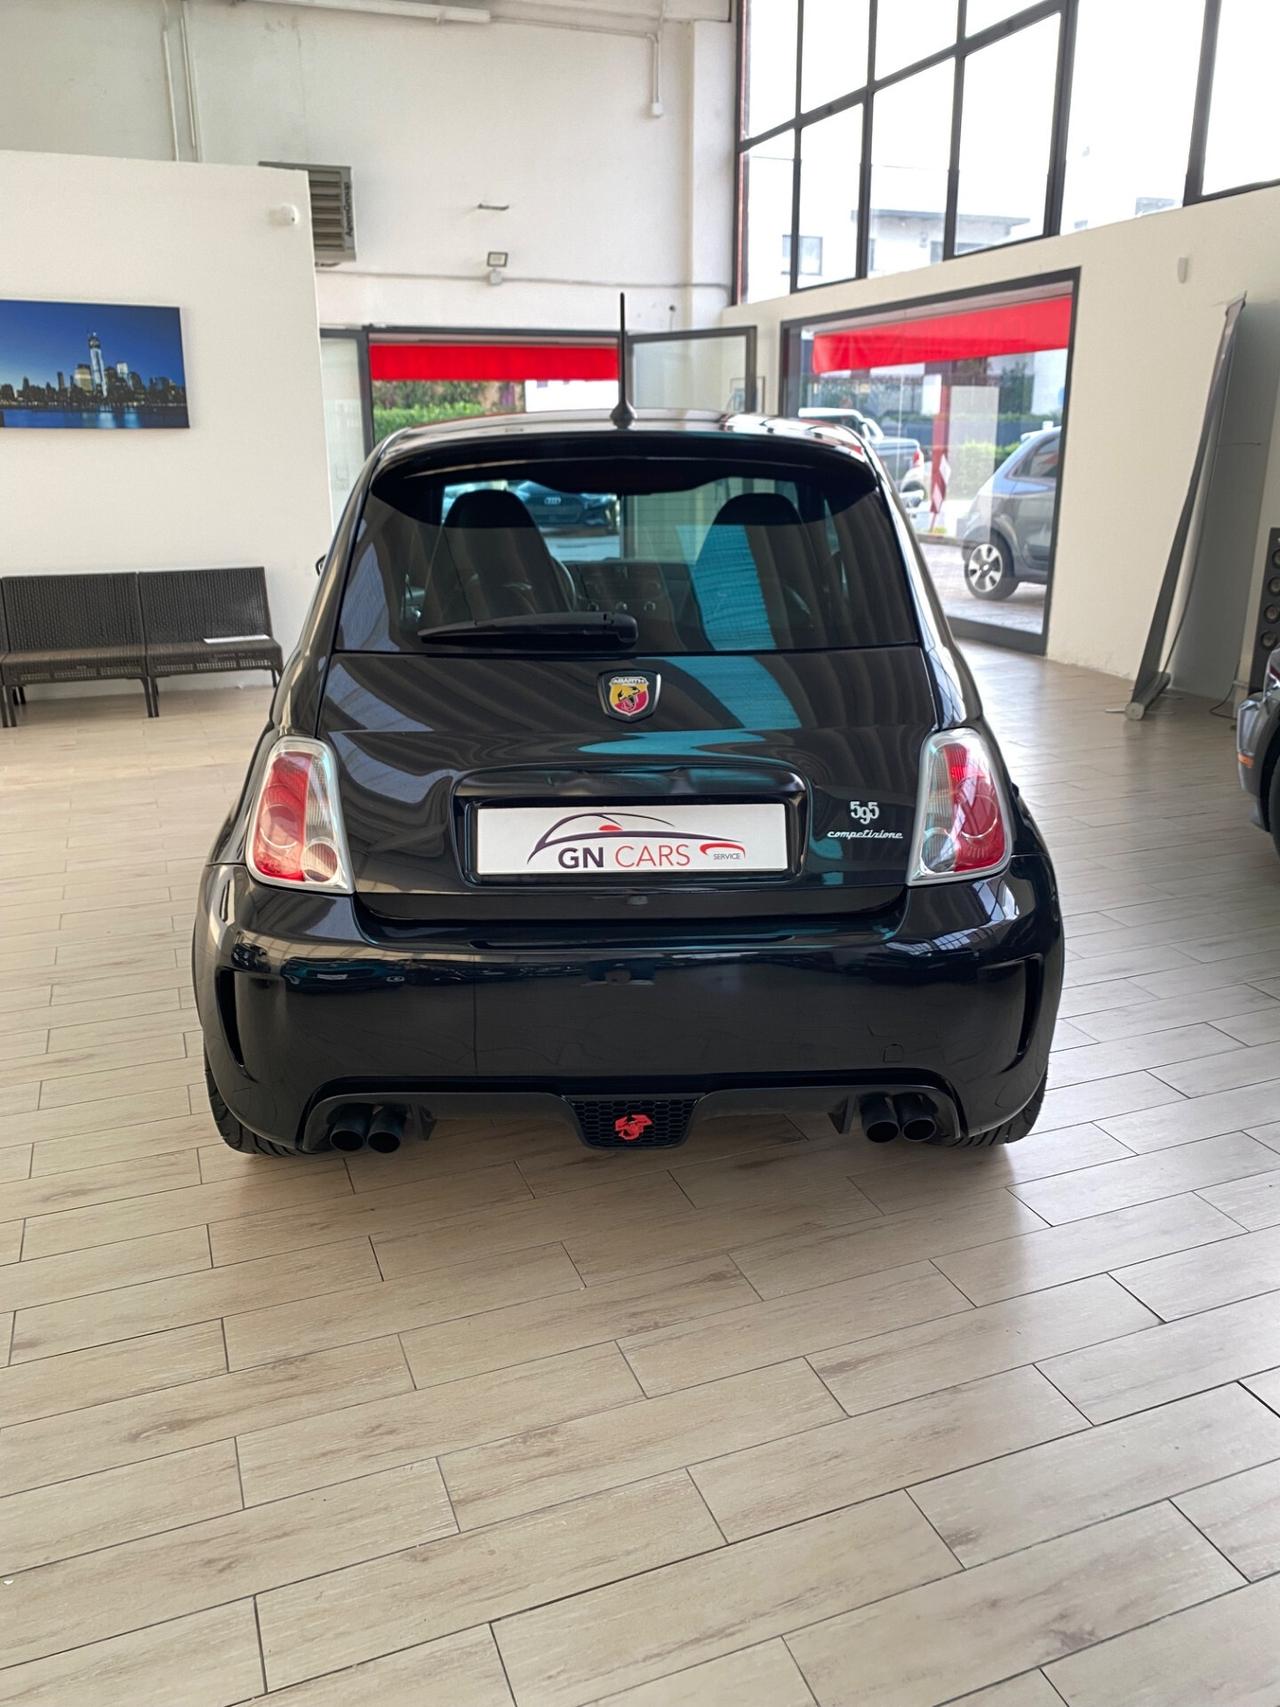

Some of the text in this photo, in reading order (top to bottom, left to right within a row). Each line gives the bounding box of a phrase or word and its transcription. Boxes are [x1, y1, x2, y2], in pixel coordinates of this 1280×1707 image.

[849, 801, 880, 825] 595
[826, 829, 904, 840] competizione
[558, 843, 691, 869] GN CARS
[713, 852, 741, 860] SERVICE
